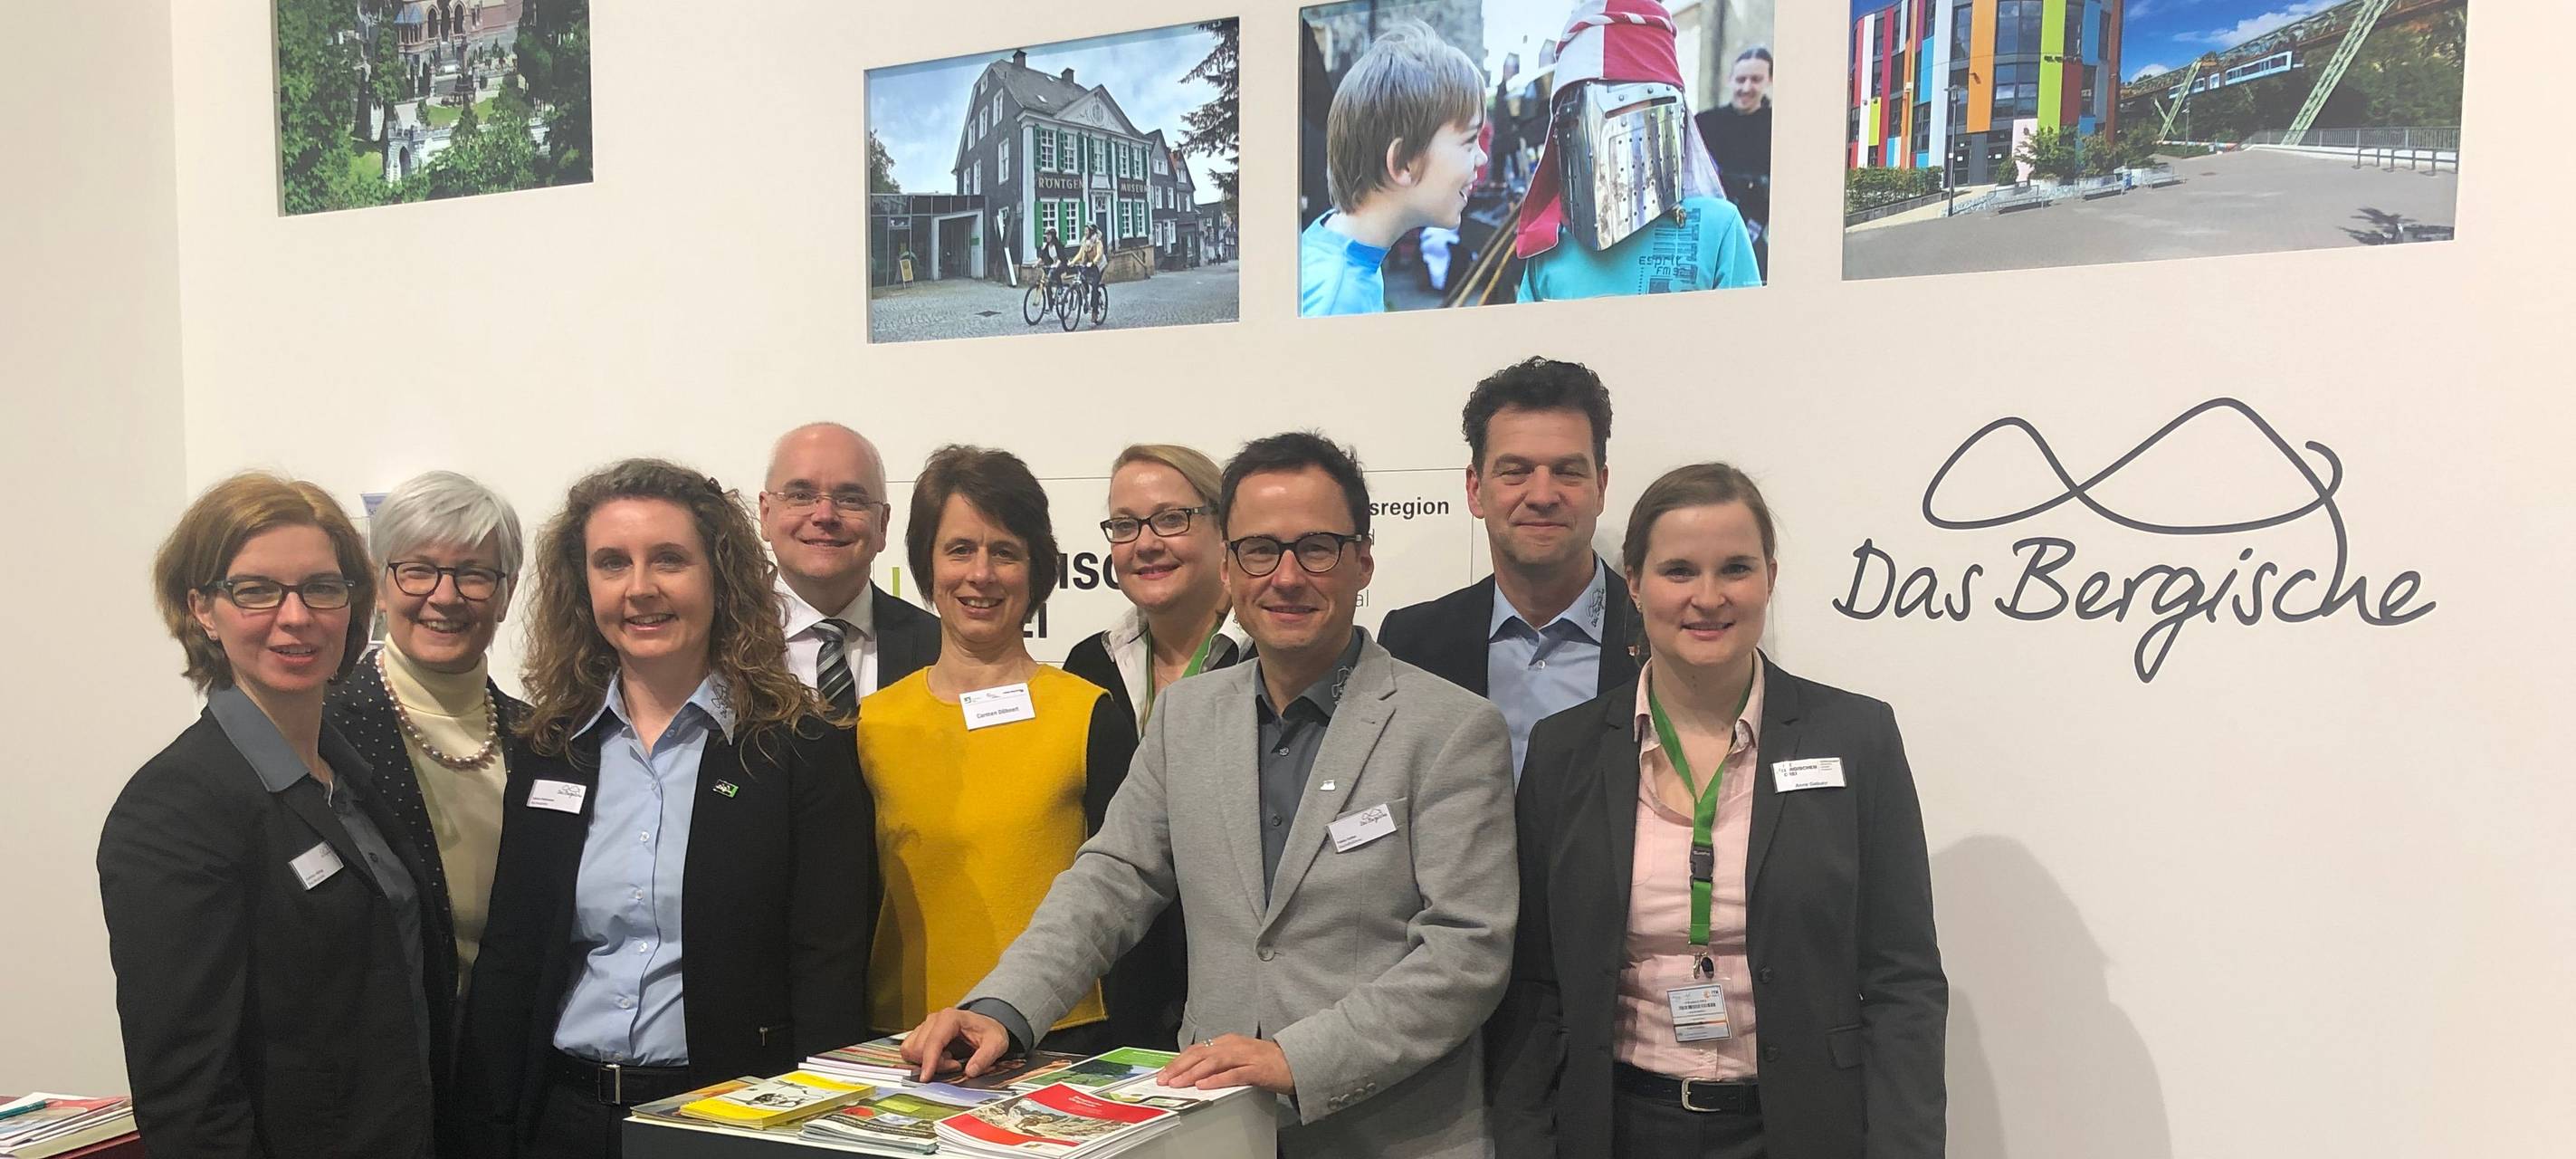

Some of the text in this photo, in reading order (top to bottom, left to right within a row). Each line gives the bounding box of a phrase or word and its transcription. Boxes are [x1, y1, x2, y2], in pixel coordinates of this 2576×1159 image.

[1038, 177, 1084, 189] RÖNTGEN
[1369, 496, 1449, 520] sregion
[1831, 536, 2437, 685] Das Bergische
